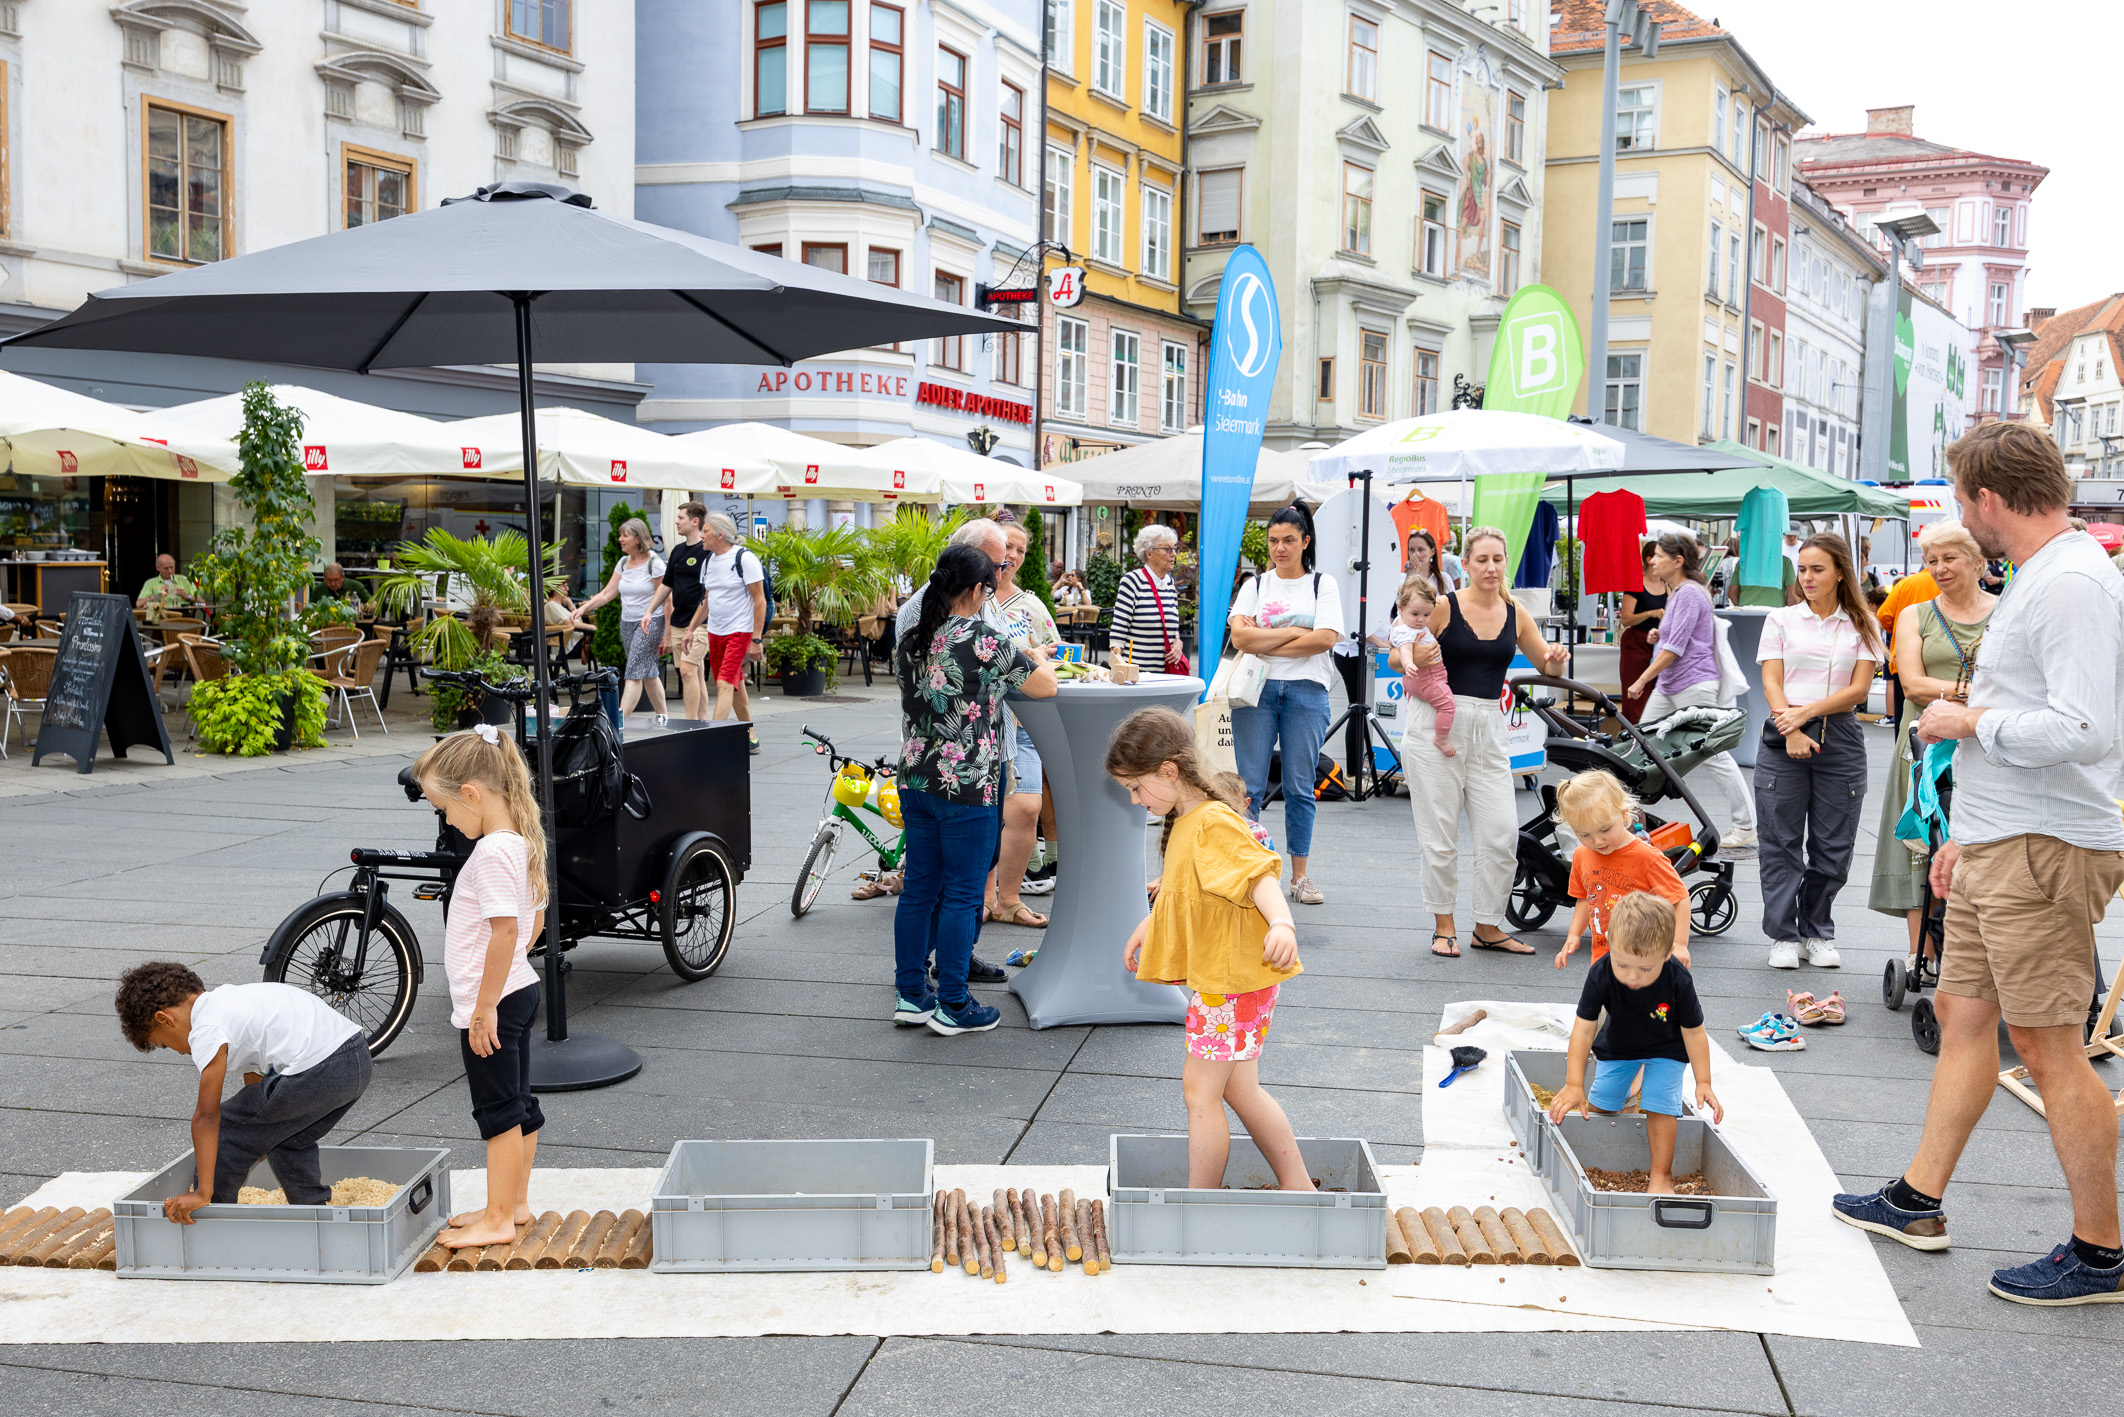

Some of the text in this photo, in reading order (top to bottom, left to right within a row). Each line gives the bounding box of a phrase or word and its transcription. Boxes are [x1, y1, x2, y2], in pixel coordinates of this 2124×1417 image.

[986, 291, 1034, 301] APOTHEKE
[1520, 324, 1557, 390] B
[757, 371, 907, 396] APOTHEKE
[916, 381, 1033, 425] ADLER APOTHEKE
[307, 449, 326, 468] illy
[464, 448, 480, 466] illy
[1388, 454, 1426, 464] RegioBus
[612, 463, 626, 480] illy
[806, 467, 818, 482] illy
[721, 471, 734, 488] illy
[894, 472, 905, 487] illy
[975, 485, 985, 499] illy
[1116, 485, 1162, 498] PRONTO
[1218, 713, 1232, 723] Au
[1218, 727, 1233, 735] un
